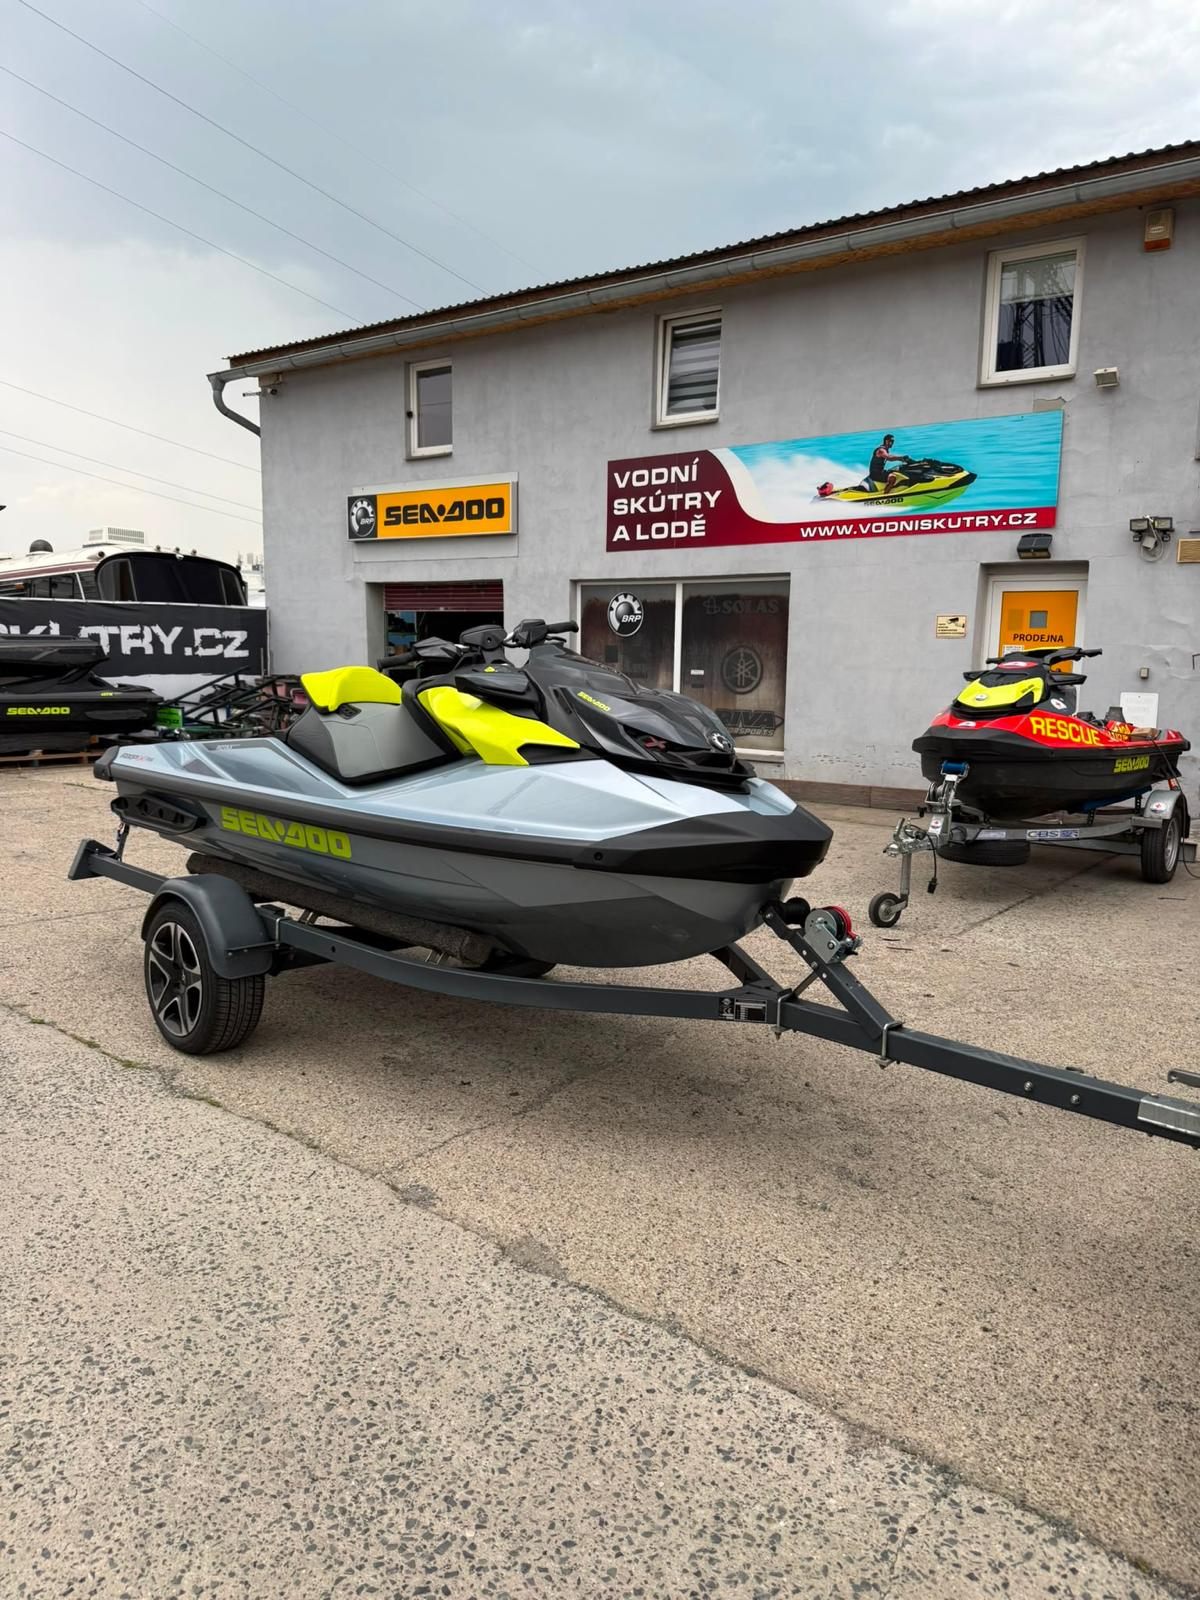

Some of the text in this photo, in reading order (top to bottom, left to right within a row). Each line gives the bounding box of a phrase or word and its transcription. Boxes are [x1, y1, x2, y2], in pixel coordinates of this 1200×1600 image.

[613, 457, 700, 489] VODNÍ
[613, 489, 722, 516] SKÚTRY
[360, 517, 375, 525] BRP
[612, 513, 706, 542] A LODĚ
[800, 512, 1037, 538] WWW.VODNISKUTRY.CZ
[621, 614, 642, 623] BRP
[721, 599, 779, 614] SOLAS
[0, 620, 249, 658] TRY.CZ
[1013, 633, 1064, 643] PRODEJNA
[1029, 716, 1101, 746] RESCUE
